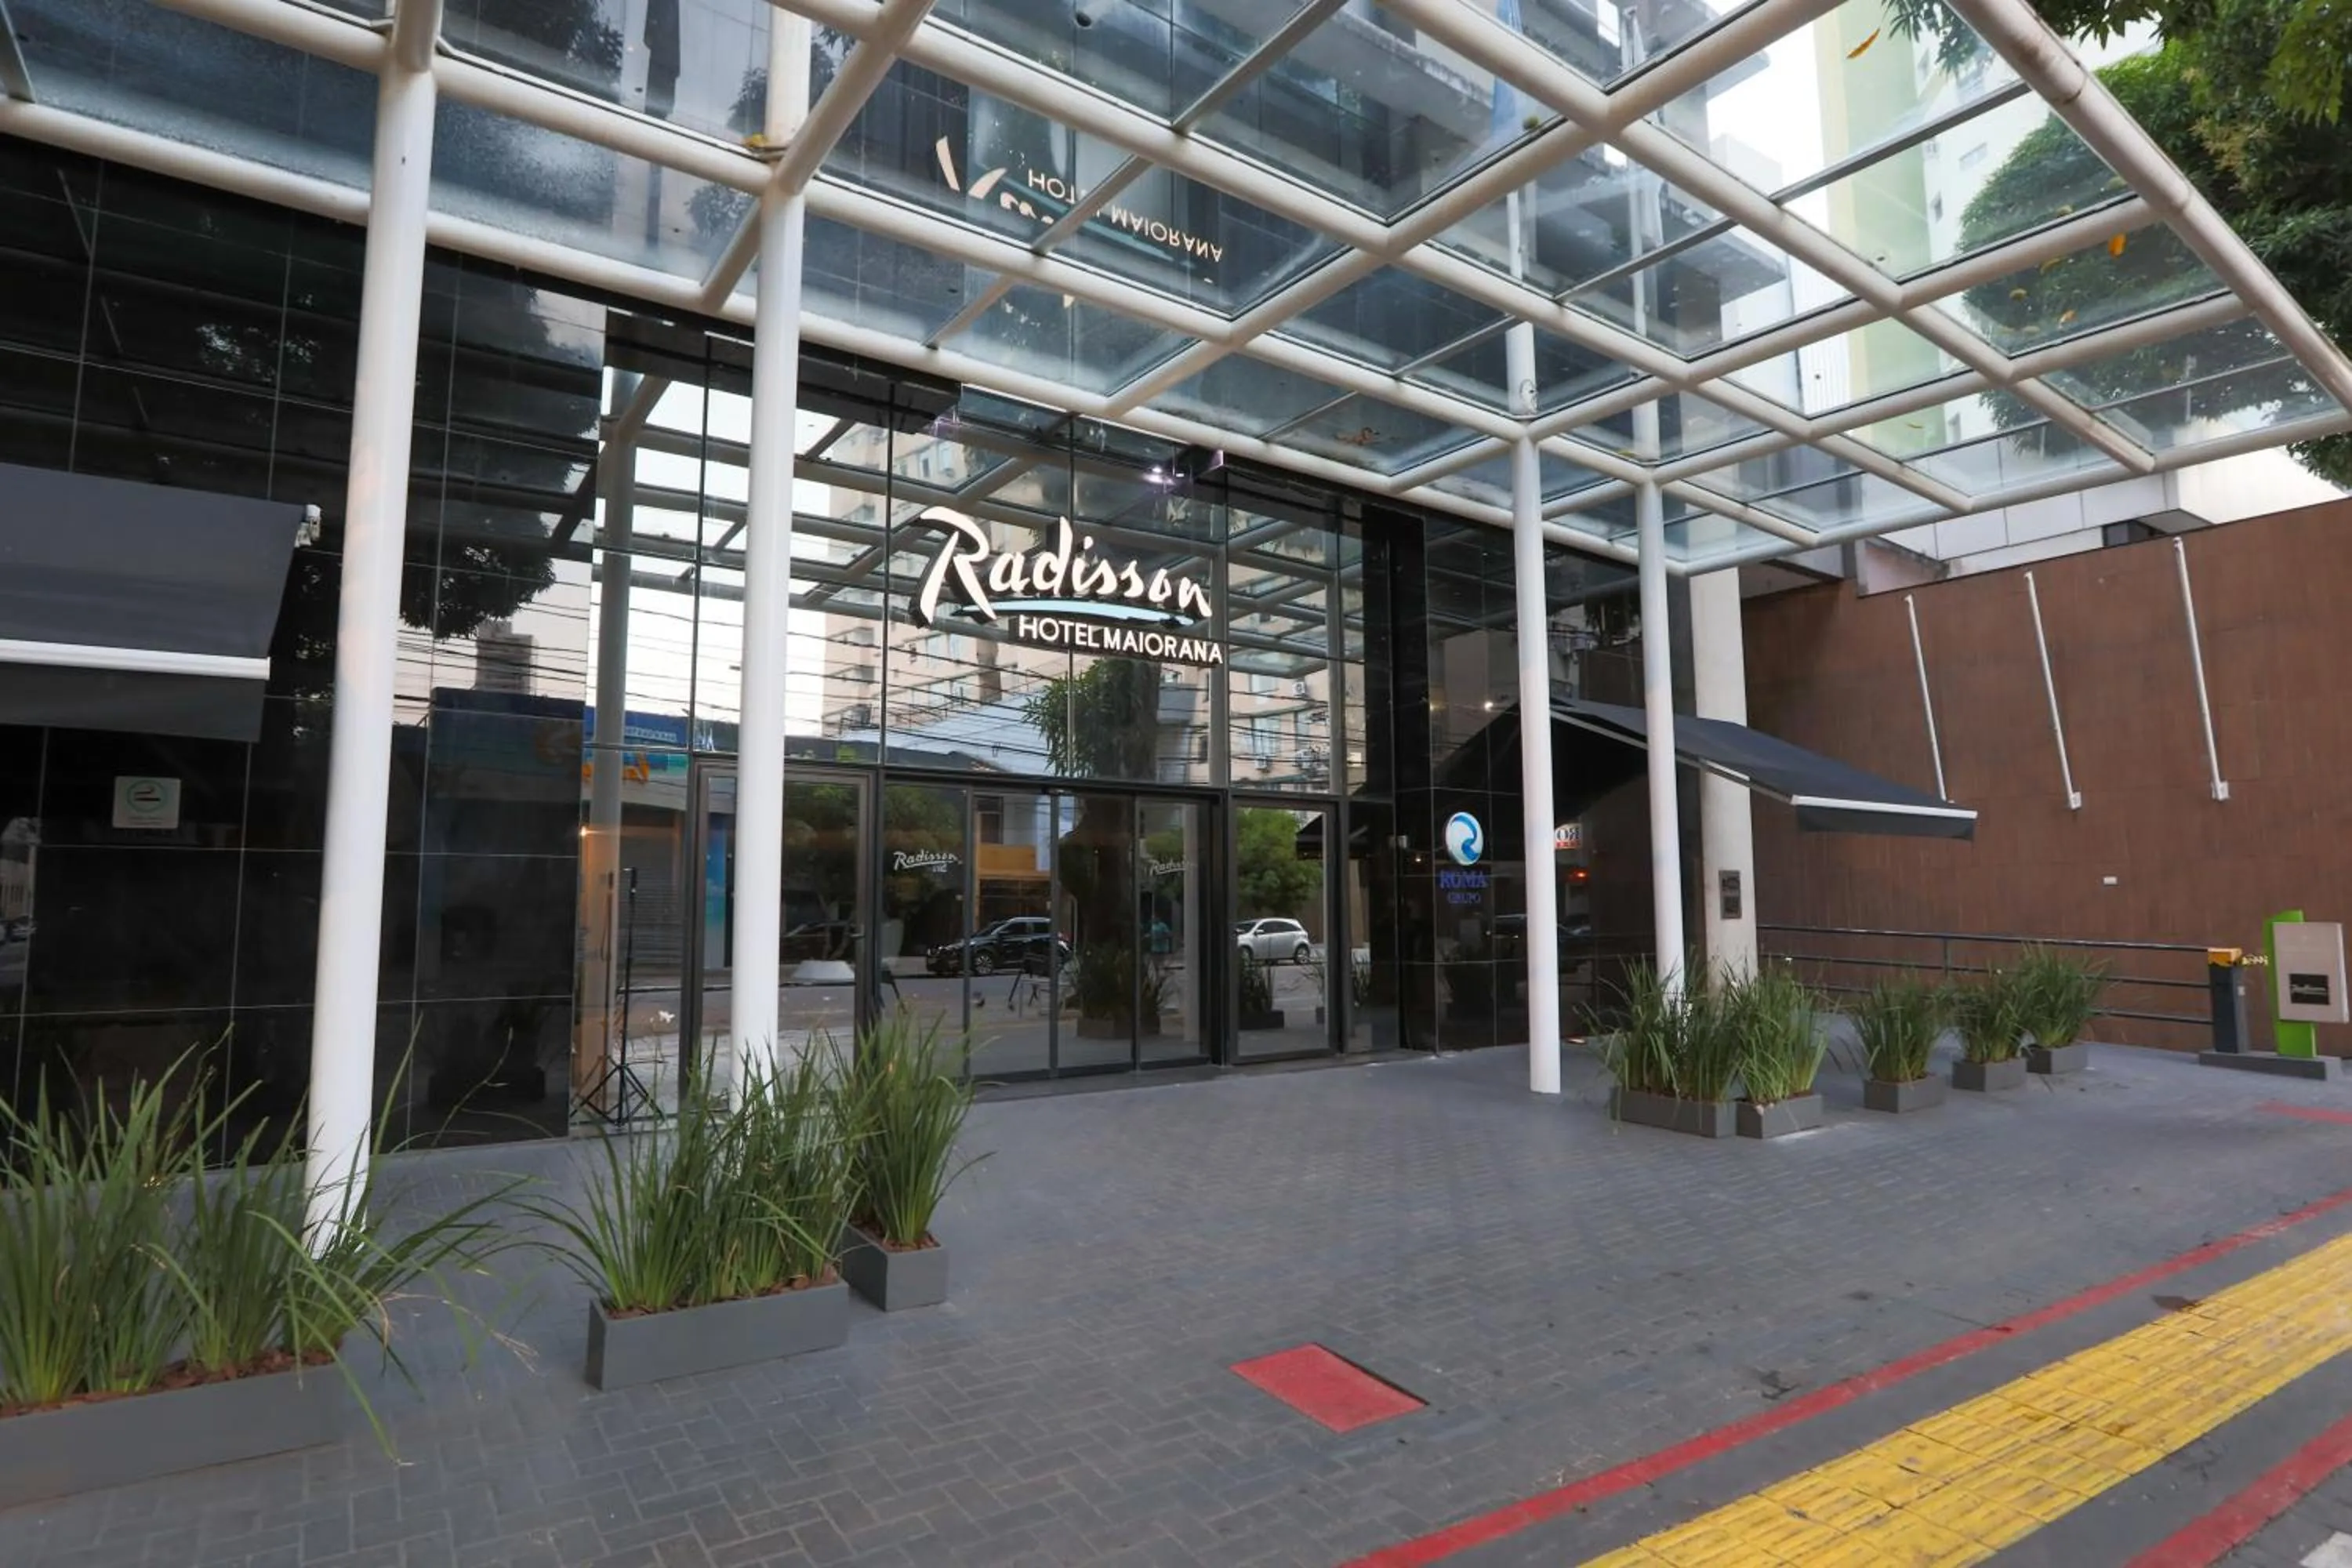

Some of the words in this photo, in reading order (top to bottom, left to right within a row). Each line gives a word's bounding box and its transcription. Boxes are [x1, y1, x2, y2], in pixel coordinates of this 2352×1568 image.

[920, 506, 1212, 625] Radisson
[1020, 615, 1099, 648] HOTEL
[1104, 627, 1222, 664] MAIORANA
[893, 848, 958, 871] Radisson
